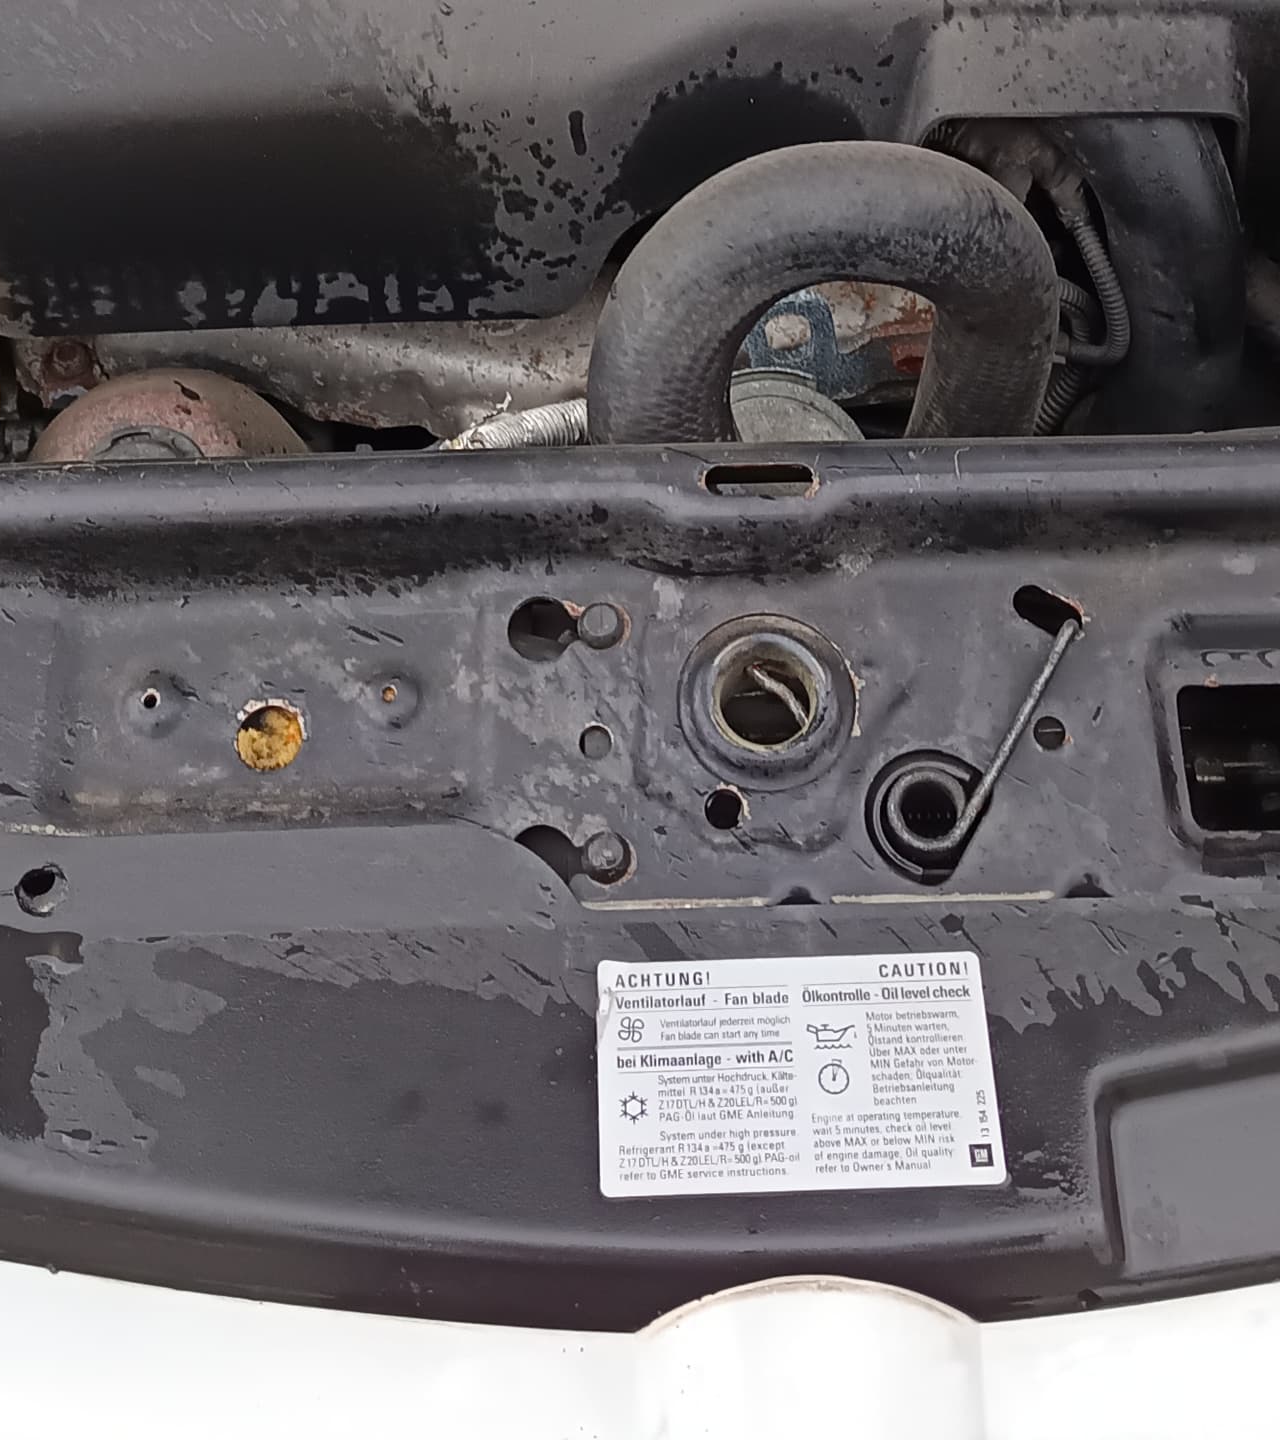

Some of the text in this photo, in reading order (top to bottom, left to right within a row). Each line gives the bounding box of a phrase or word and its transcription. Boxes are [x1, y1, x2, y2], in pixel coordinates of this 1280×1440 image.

[879, 962, 968, 977] CAUTION!
[616, 972, 710, 988] ACHTUNG!
[803, 985, 870, 1003] Ölkontrolle
[882, 987, 898, 1000] Oil
[901, 986, 929, 999] level
[932, 985, 970, 998] check
[616, 994, 705, 1009] Ventilatorlauf
[725, 992, 748, 1005] Fan
[753, 992, 789, 1004] blade
[866, 1012, 892, 1020] Motor
[660, 1019, 716, 1029] Ventilatorlauf
[719, 1018, 754, 1028] jederzeit
[874, 1023, 912, 1032] Minuten
[661, 1032, 675, 1040] Fan
[678, 1031, 701, 1040] blade
[744, 1031, 758, 1039] any
[761, 1029, 779, 1037] time
[895, 1047, 916, 1055] MAX
[920, 1046, 939, 1054] oder
[943, 1046, 967, 1054] unter
[617, 1055, 636, 1068] bei
[640, 1053, 721, 1068] Klimaanlage
[736, 1051, 764, 1064] with
[768, 1049, 793, 1063] A/C
[871, 1060, 890, 1068] MIN
[894, 1058, 925, 1068] Gefahr
[928, 1058, 943, 1067] von
[658, 1075, 690, 1086] System
[692, 1075, 715, 1084] unter
[658, 1088, 685, 1097] mittel
[873, 1082, 955, 1093] Betriebsanleitung
[874, 1096, 917, 1106] beachten
[720, 1110, 743, 1120] GME
[747, 1109, 794, 1119] Anleitung
[812, 1113, 843, 1125] Engine
[846, 1113, 854, 1122] at
[857, 1112, 900, 1123] operating
[813, 1125, 832, 1135] wait
[836, 1125, 841, 1135] 5
[886, 1123, 912, 1133] check
[916, 1122, 927, 1132] oil
[930, 1122, 951, 1131] level
[660, 1131, 695, 1141] System
[698, 1130, 726, 1139] under
[730, 1129, 750, 1141] high
[814, 1134, 955, 1148] above MAX or below MIN risk
[619, 1145, 675, 1158] Refrigerant
[815, 1152, 823, 1160] of
[827, 1151, 859, 1161] engine
[906, 1148, 918, 1157] Oil
[816, 1163, 837, 1173] refer
[841, 1163, 849, 1172] to
[619, 1170, 643, 1181] refer
[648, 1170, 656, 1180] to
[660, 1170, 684, 1180] GME
[688, 1169, 724, 1179] service
